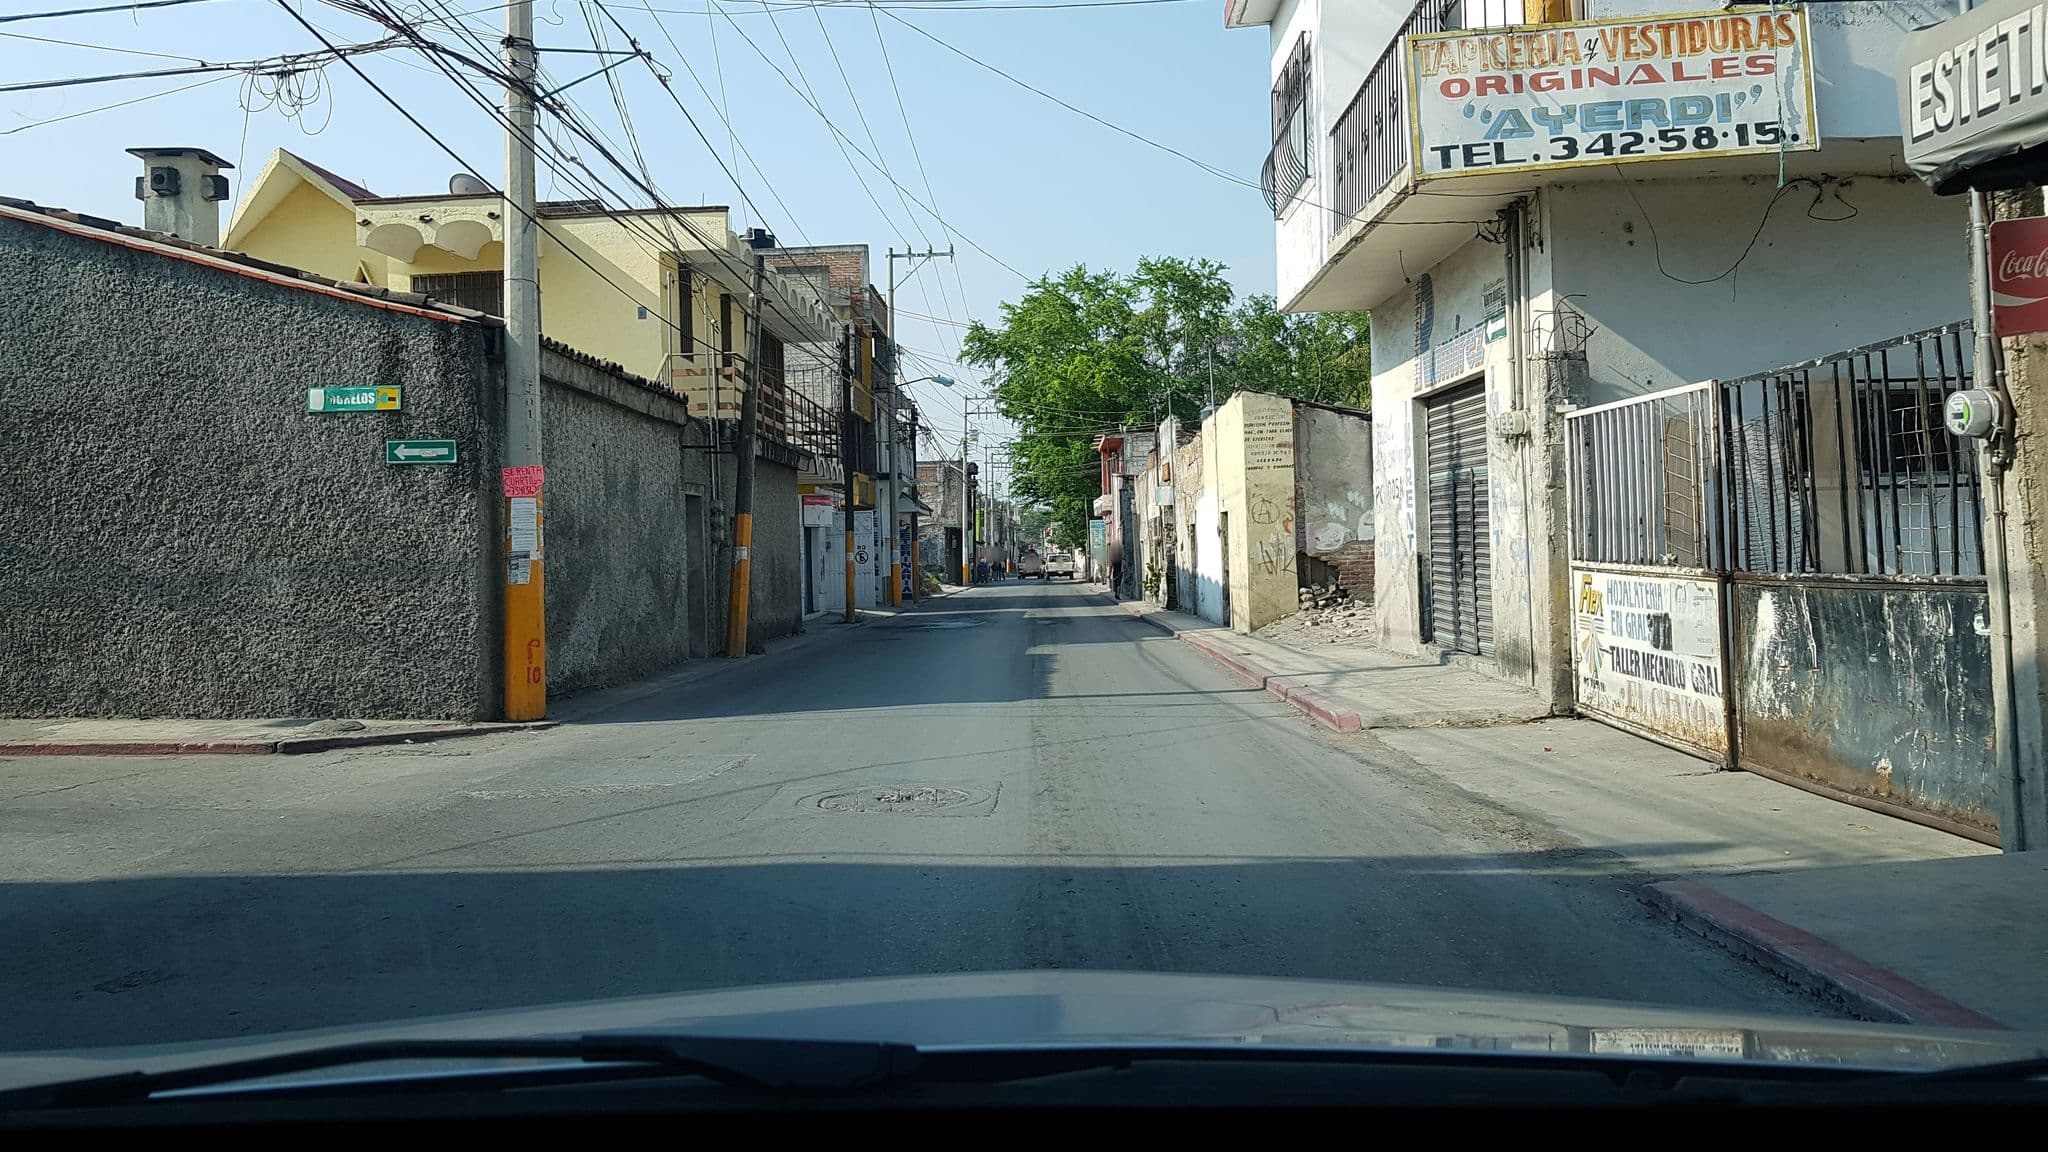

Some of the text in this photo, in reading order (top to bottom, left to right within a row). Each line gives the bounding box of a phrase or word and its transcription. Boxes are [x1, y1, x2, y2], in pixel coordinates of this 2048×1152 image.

[1416, 31, 1584, 78] TAPICERIA
[1598, 13, 1796, 63] VESTIDURAS
[1440, 55, 1775, 98] ORIGINALES
[1909, 3, 2048, 143] ESTETI
[504, 465, 542, 477] SE RENTA
[1606, 579, 1664, 611] HOJALATERIA
[1610, 611, 1623, 638] EN
[1609, 645, 1641, 678] TALLER
[1642, 651, 1686, 691] MECANICO
